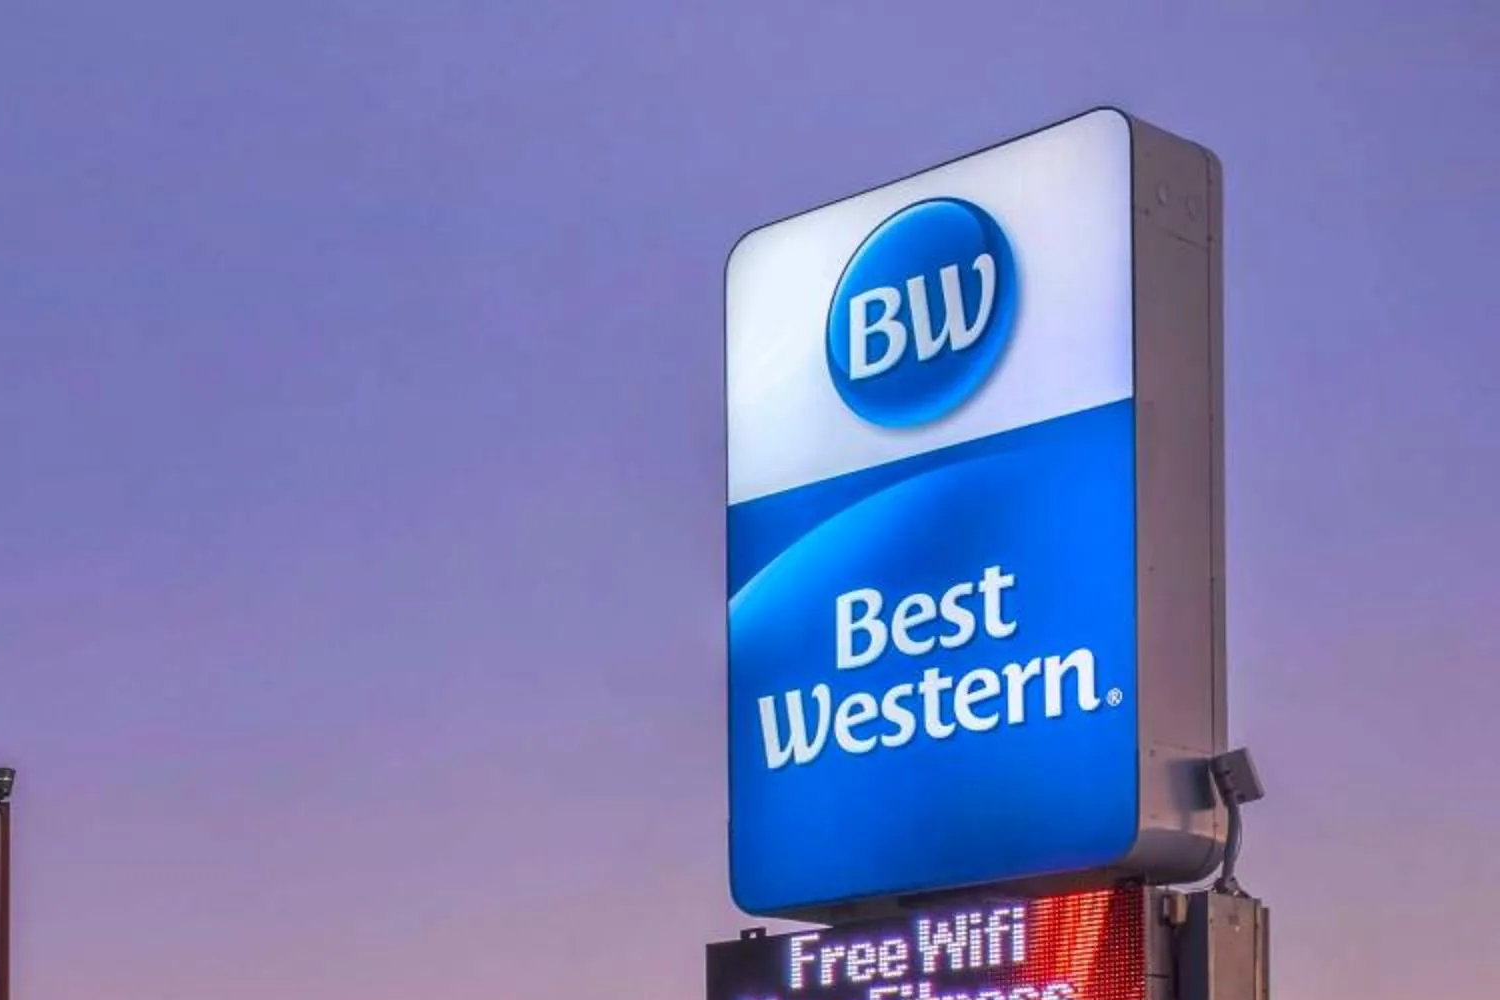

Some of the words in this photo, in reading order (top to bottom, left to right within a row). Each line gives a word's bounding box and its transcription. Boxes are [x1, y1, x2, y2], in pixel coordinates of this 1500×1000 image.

[849, 252, 997, 382] BW
[835, 564, 1018, 670] Best
[790, 932, 908, 989] Free
[918, 906, 1026, 973] Wifi
